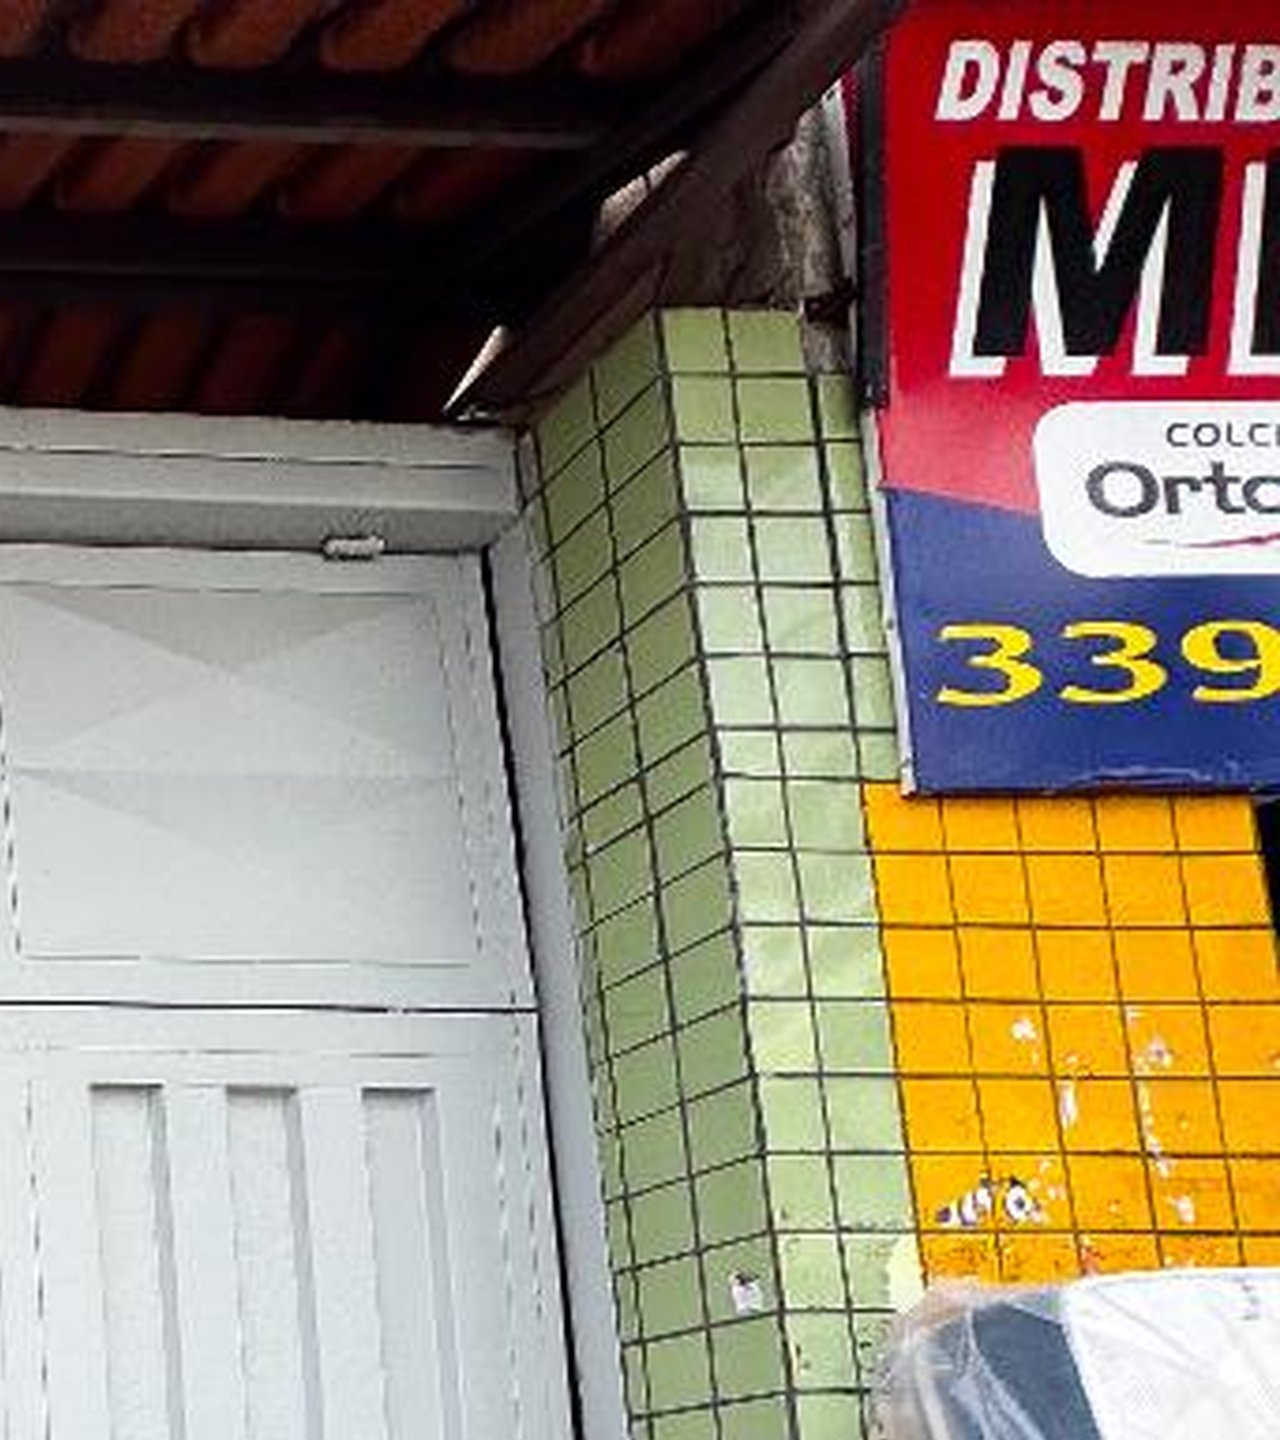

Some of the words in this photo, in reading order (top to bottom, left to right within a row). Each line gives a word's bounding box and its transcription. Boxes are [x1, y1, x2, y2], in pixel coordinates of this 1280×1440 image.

[933, 39, 1280, 123] DISTRIB
[947, 144, 1280, 379] M
[937, 620, 1280, 707] 339
